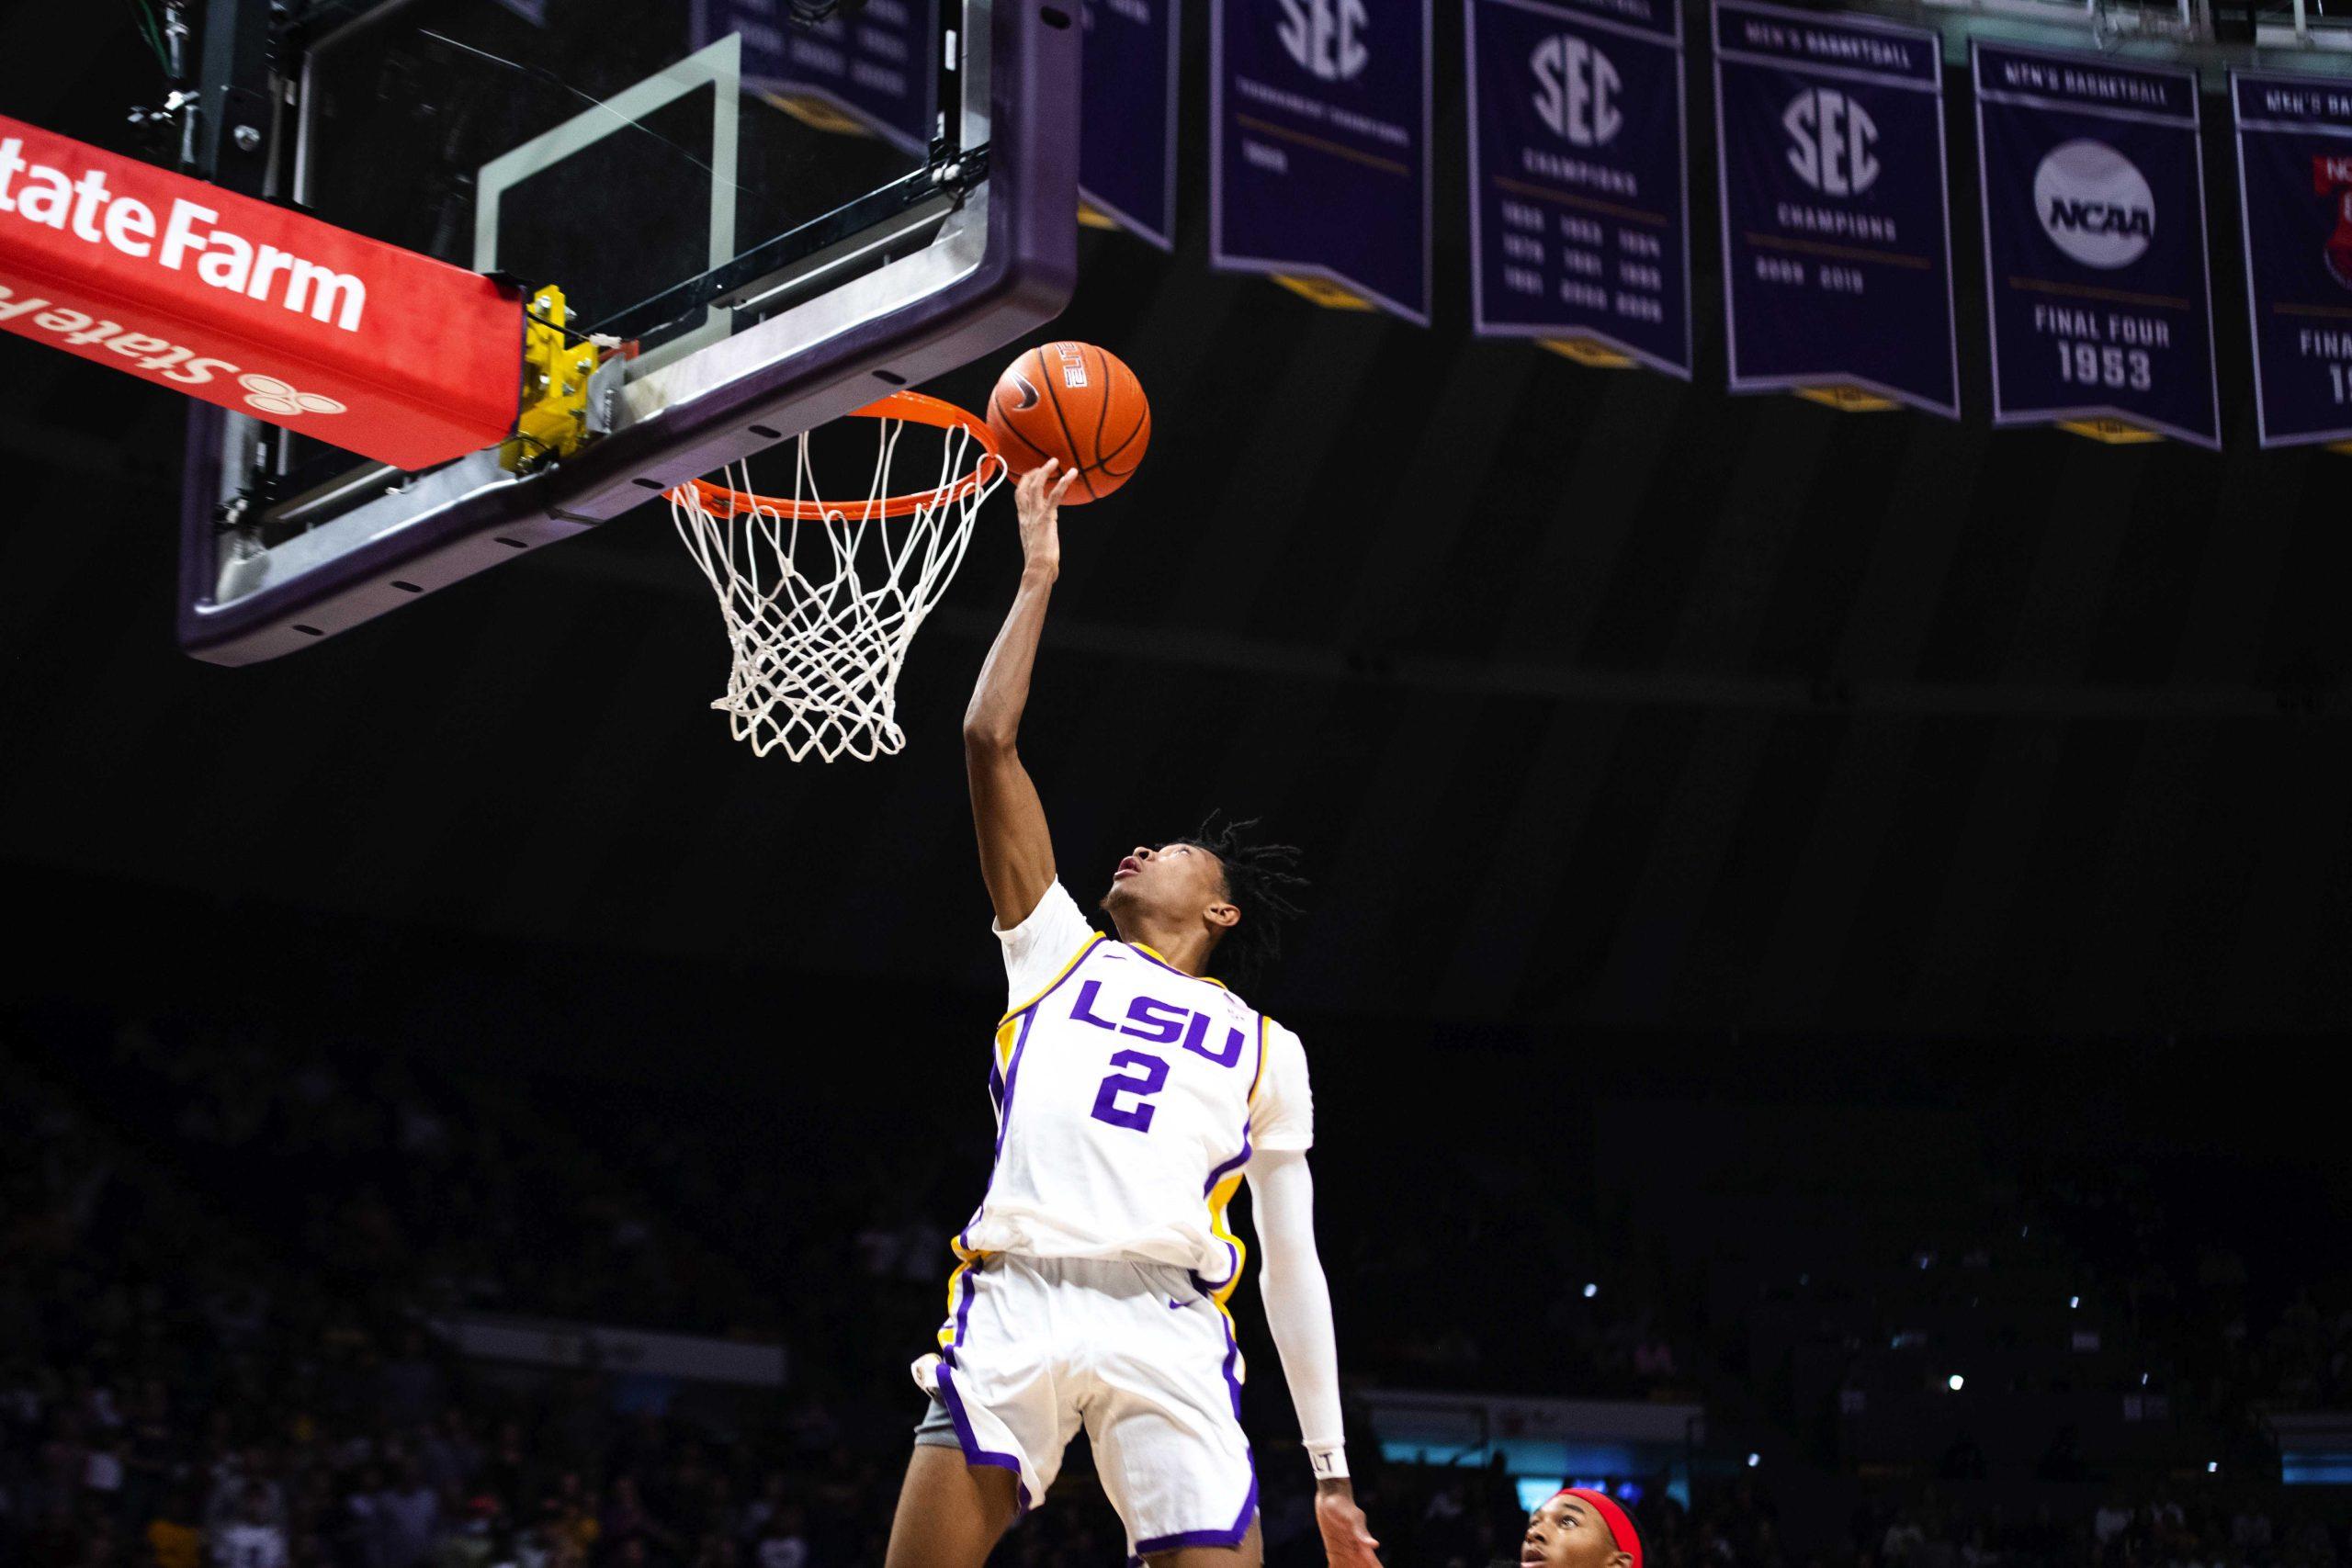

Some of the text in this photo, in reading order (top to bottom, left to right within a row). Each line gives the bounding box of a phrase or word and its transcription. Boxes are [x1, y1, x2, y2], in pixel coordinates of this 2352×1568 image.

[1276, 0, 1368, 80] SEC
[1529, 34, 1623, 146] SEC
[2064, 67, 2167, 107] BASKETBALL
[2328, 94, 2352, 117] BA
[1781, 88, 1881, 197] SEC
[1777, 201, 1897, 243] CHAMPIONS
[2050, 197, 2151, 238] NCAA
[2034, 304, 2171, 349] FINAL FOUR
[2057, 338, 2153, 391] 1953
[2330, 363, 2352, 405] 1
[1069, 979, 1246, 1068] LSU
[1091, 1049, 1170, 1134] 2
